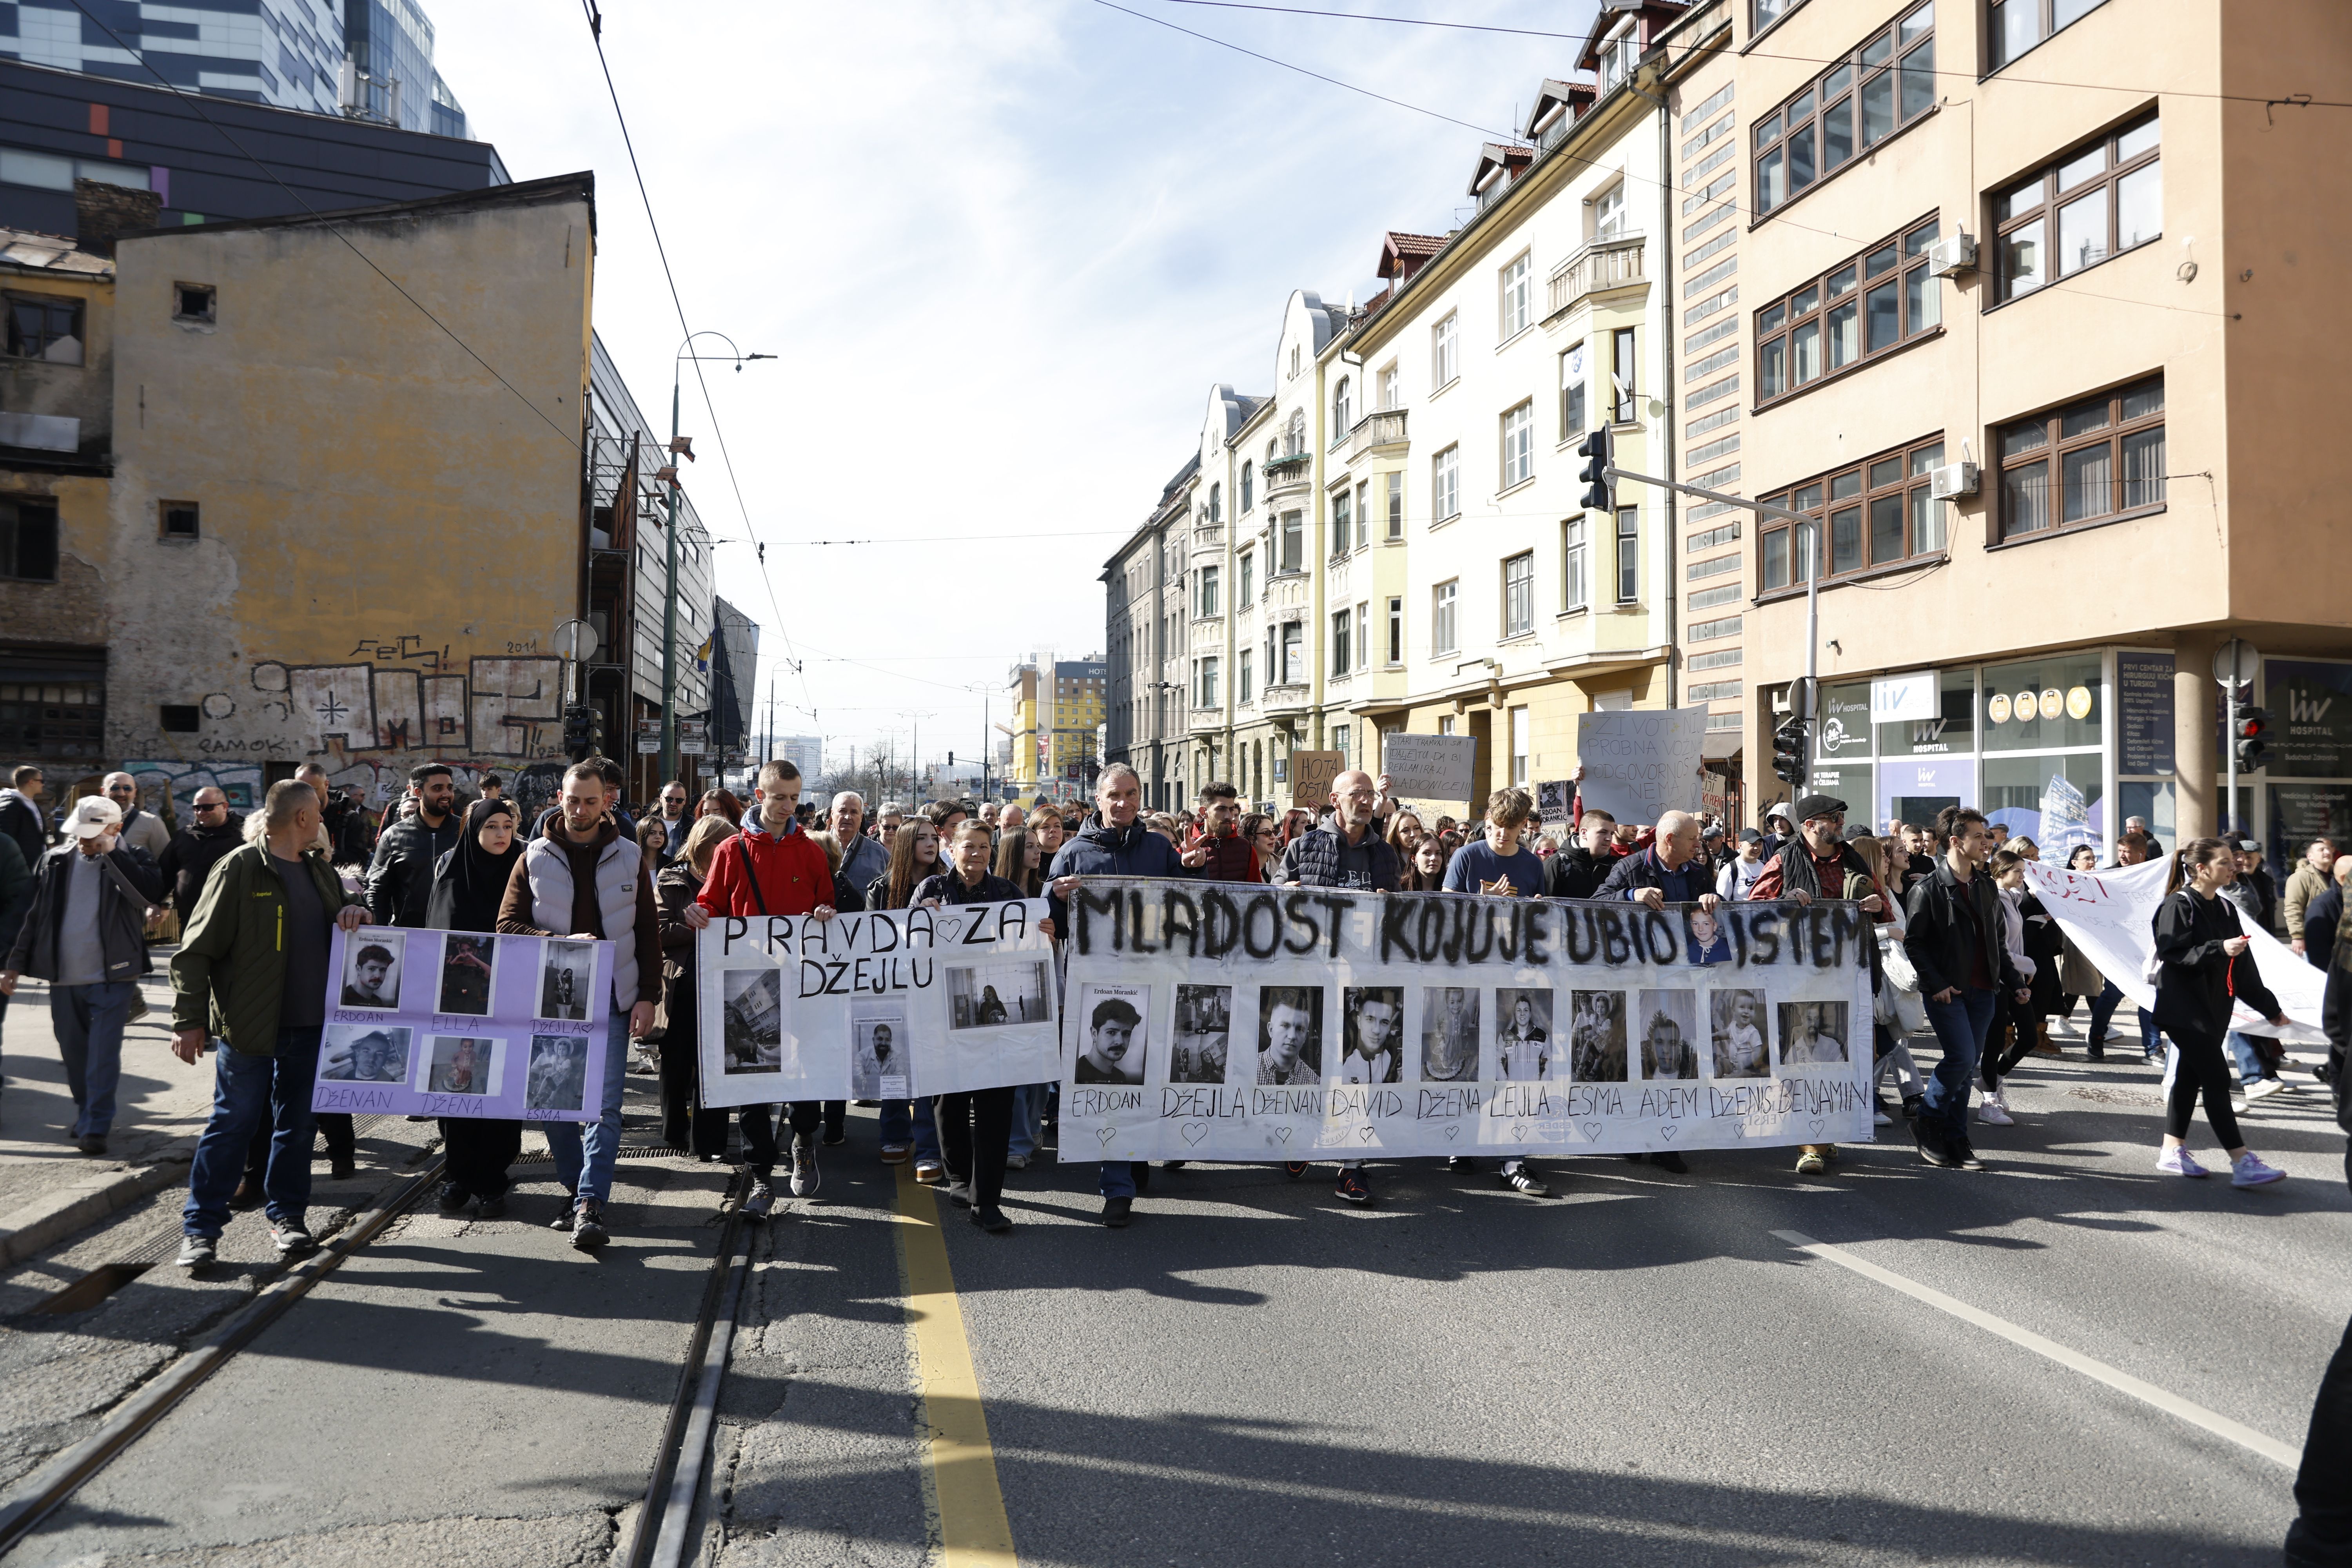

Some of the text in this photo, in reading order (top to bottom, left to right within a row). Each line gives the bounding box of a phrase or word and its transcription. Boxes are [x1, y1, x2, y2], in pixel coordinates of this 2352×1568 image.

[507, 639, 538, 653] 2011
[1843, 703, 1868, 712] HOSPITAL
[1595, 713, 1675, 736] ŽIVOT
[2290, 726, 2332, 735] HOSPITAL
[1390, 737, 1411, 746] STARI
[1586, 739, 1658, 756] PROBNA
[1913, 743, 1948, 753] HOSPITAL
[1433, 752, 1445, 762] DA
[1451, 753, 1461, 762] BI
[1388, 762, 1446, 776] REKLAMIRALI
[1629, 780, 1680, 799] NEMA
[1538, 807, 1562, 816] ERDOAN
[724, 901, 1026, 956] PRAVDA ZA
[1076, 886, 1356, 958] MLADOST
[1567, 907, 1679, 965] UBIO
[1728, 907, 1871, 969] ISTEM
[798, 953, 933, 998] DŽEJLU
[334, 1011, 383, 1022] ERDOAN
[431, 1015, 479, 1033] ELLA
[529, 1020, 581, 1035] DŽEJLA
[316, 1087, 394, 1109] DŽENAN
[420, 1093, 483, 1117] DŽENA
[1073, 1078, 1867, 1120] ERDOAN DŽEJLA DŽENAN DAVID DŽENA LEJLA ESMA ADEM DŽENIS BENJAMIN
[526, 1109, 561, 1122] ESMA
